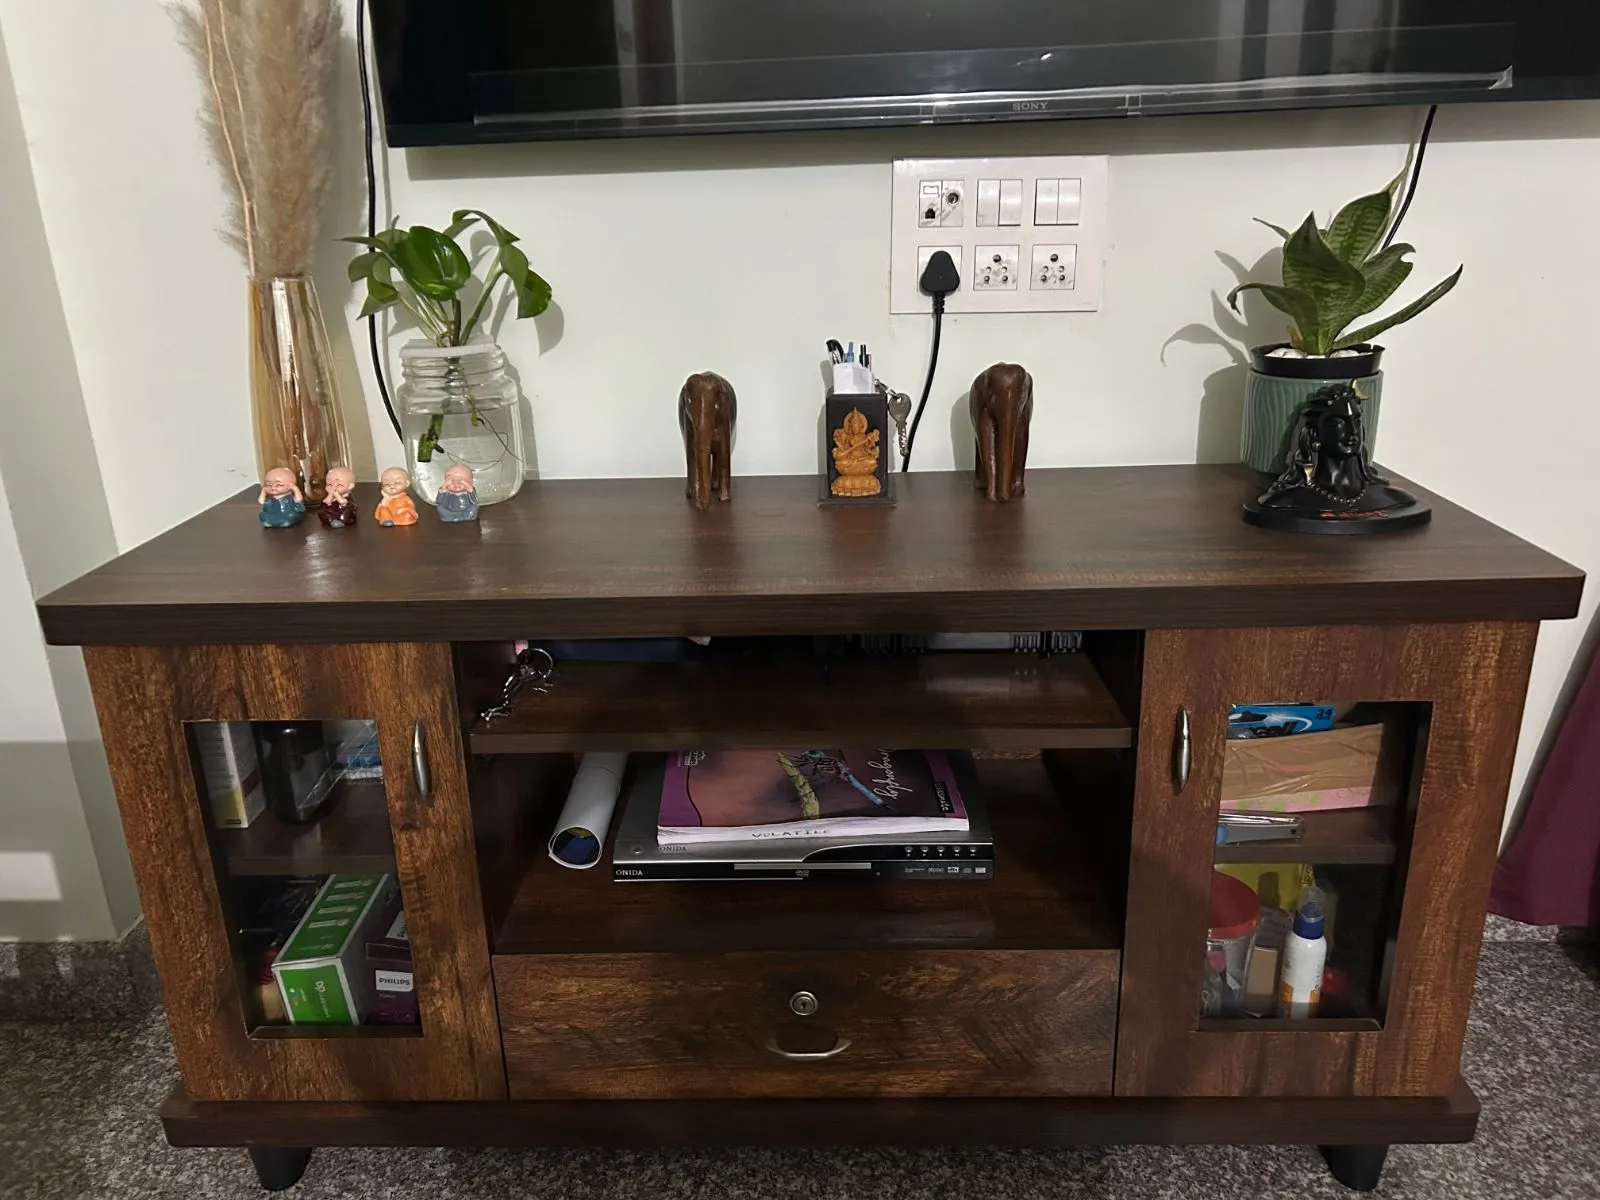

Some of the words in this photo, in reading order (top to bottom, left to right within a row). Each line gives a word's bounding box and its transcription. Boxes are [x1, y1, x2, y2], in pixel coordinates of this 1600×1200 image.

[1012, 101, 1049, 111] SONY
[1317, 708, 1332, 716] 24
[659, 845, 687, 853] ONIDA
[615, 869, 643, 877] ONIDA
[379, 977, 411, 986] PHILIPS
